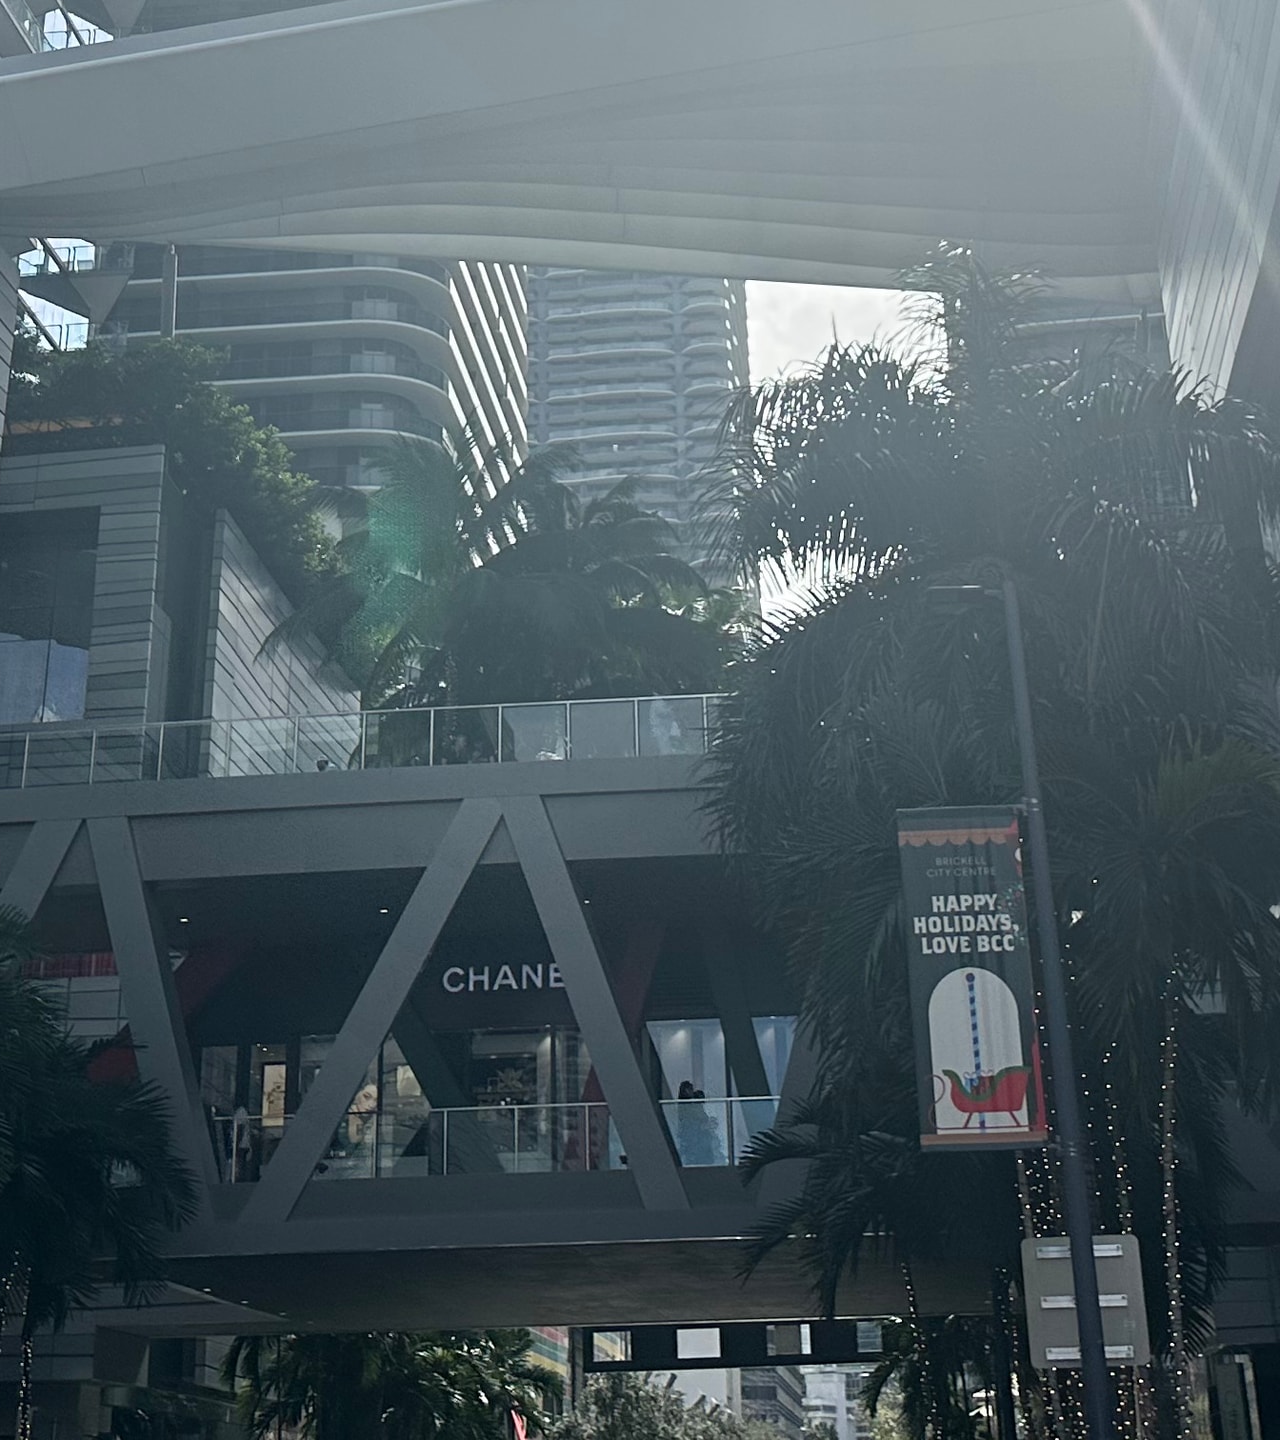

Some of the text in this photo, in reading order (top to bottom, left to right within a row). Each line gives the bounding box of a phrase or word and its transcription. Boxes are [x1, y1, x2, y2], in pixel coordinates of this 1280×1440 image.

[935, 856, 987, 866] BRICKELL
[926, 866, 998, 878] CITY CENTRE
[931, 893, 998, 913] HAPPY
[913, 913, 1020, 936] HOLIDAYS,
[921, 934, 1015, 954] LOVE BCC
[442, 962, 566, 993] CHANE
